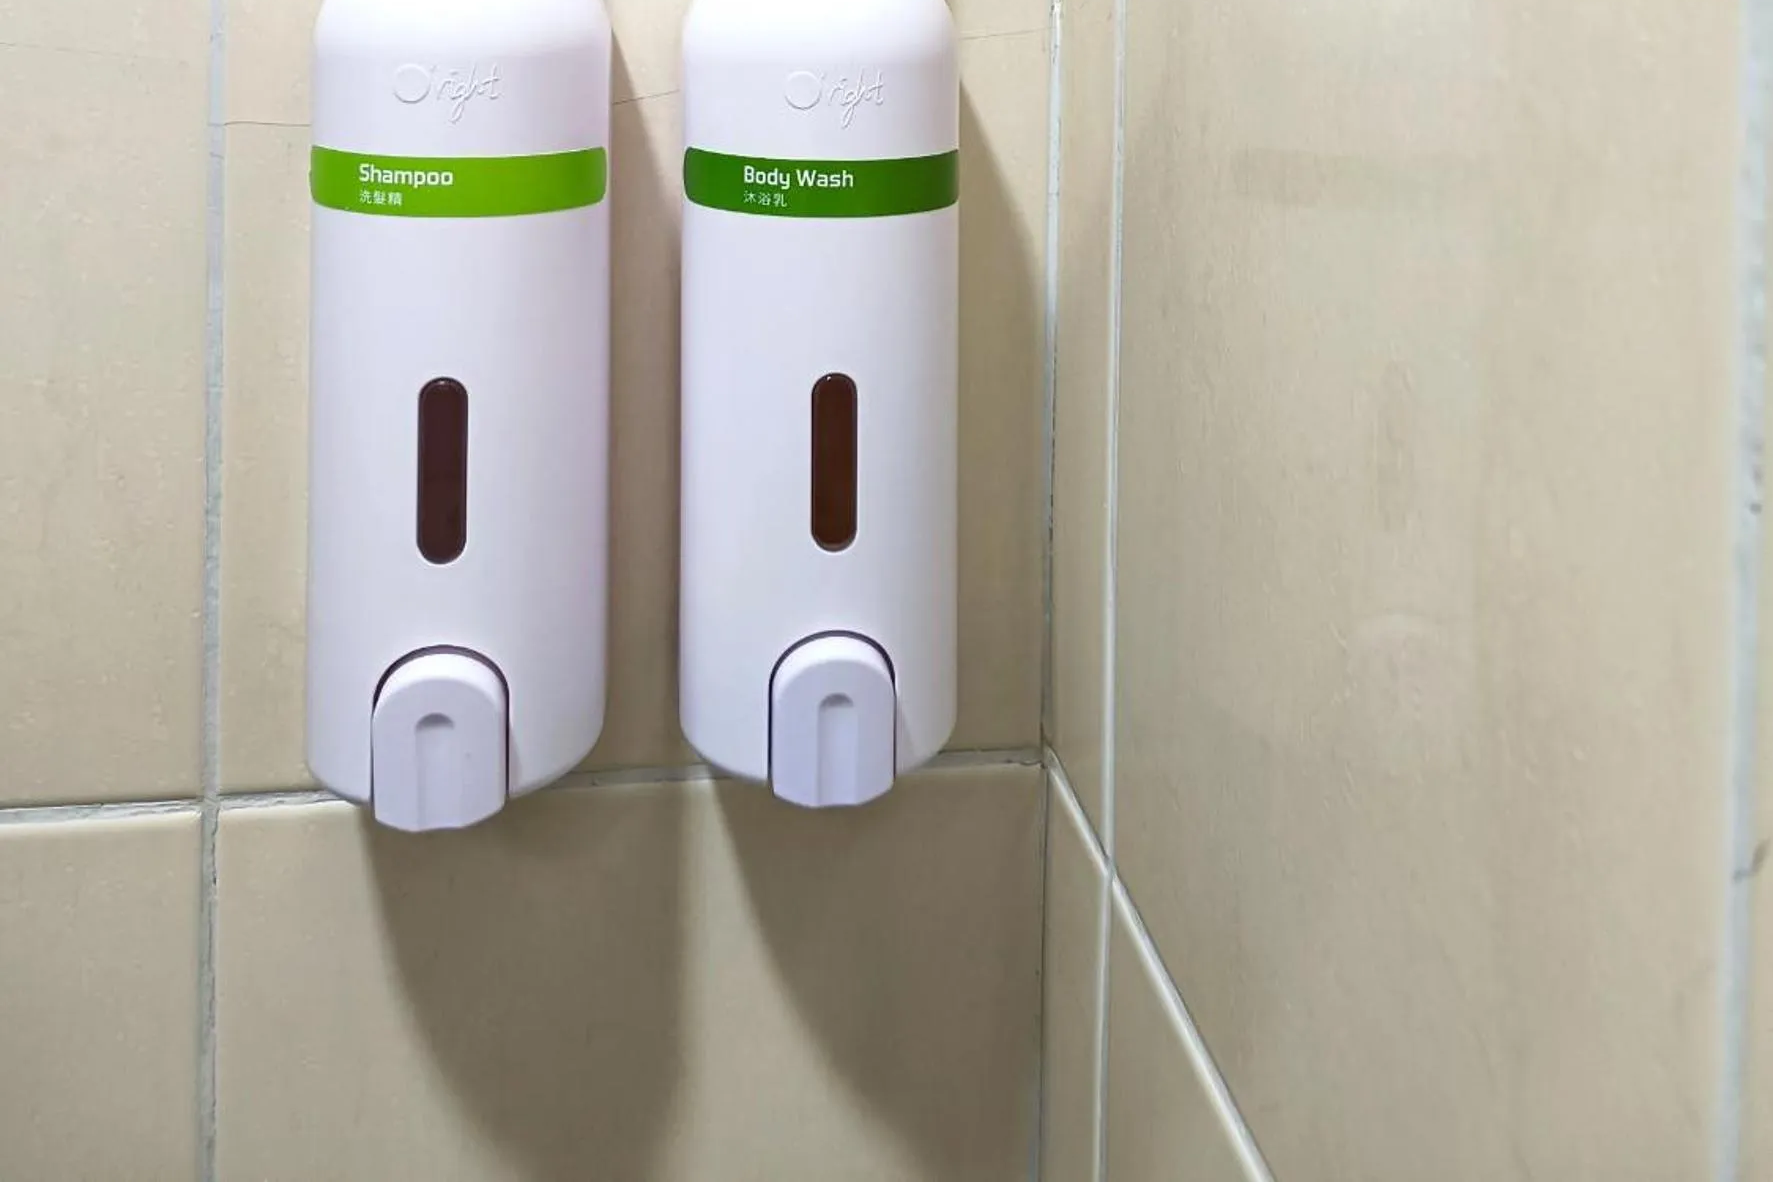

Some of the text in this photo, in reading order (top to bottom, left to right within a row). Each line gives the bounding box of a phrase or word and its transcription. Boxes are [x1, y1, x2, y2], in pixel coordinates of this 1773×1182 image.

[393, 63, 504, 124] O'right
[785, 68, 884, 129] O'right
[359, 163, 453, 189] Shampoo
[744, 165, 854, 190] Body Wash
[360, 189, 402, 206] 洗髮精
[743, 190, 787, 207] 沐浴乳
